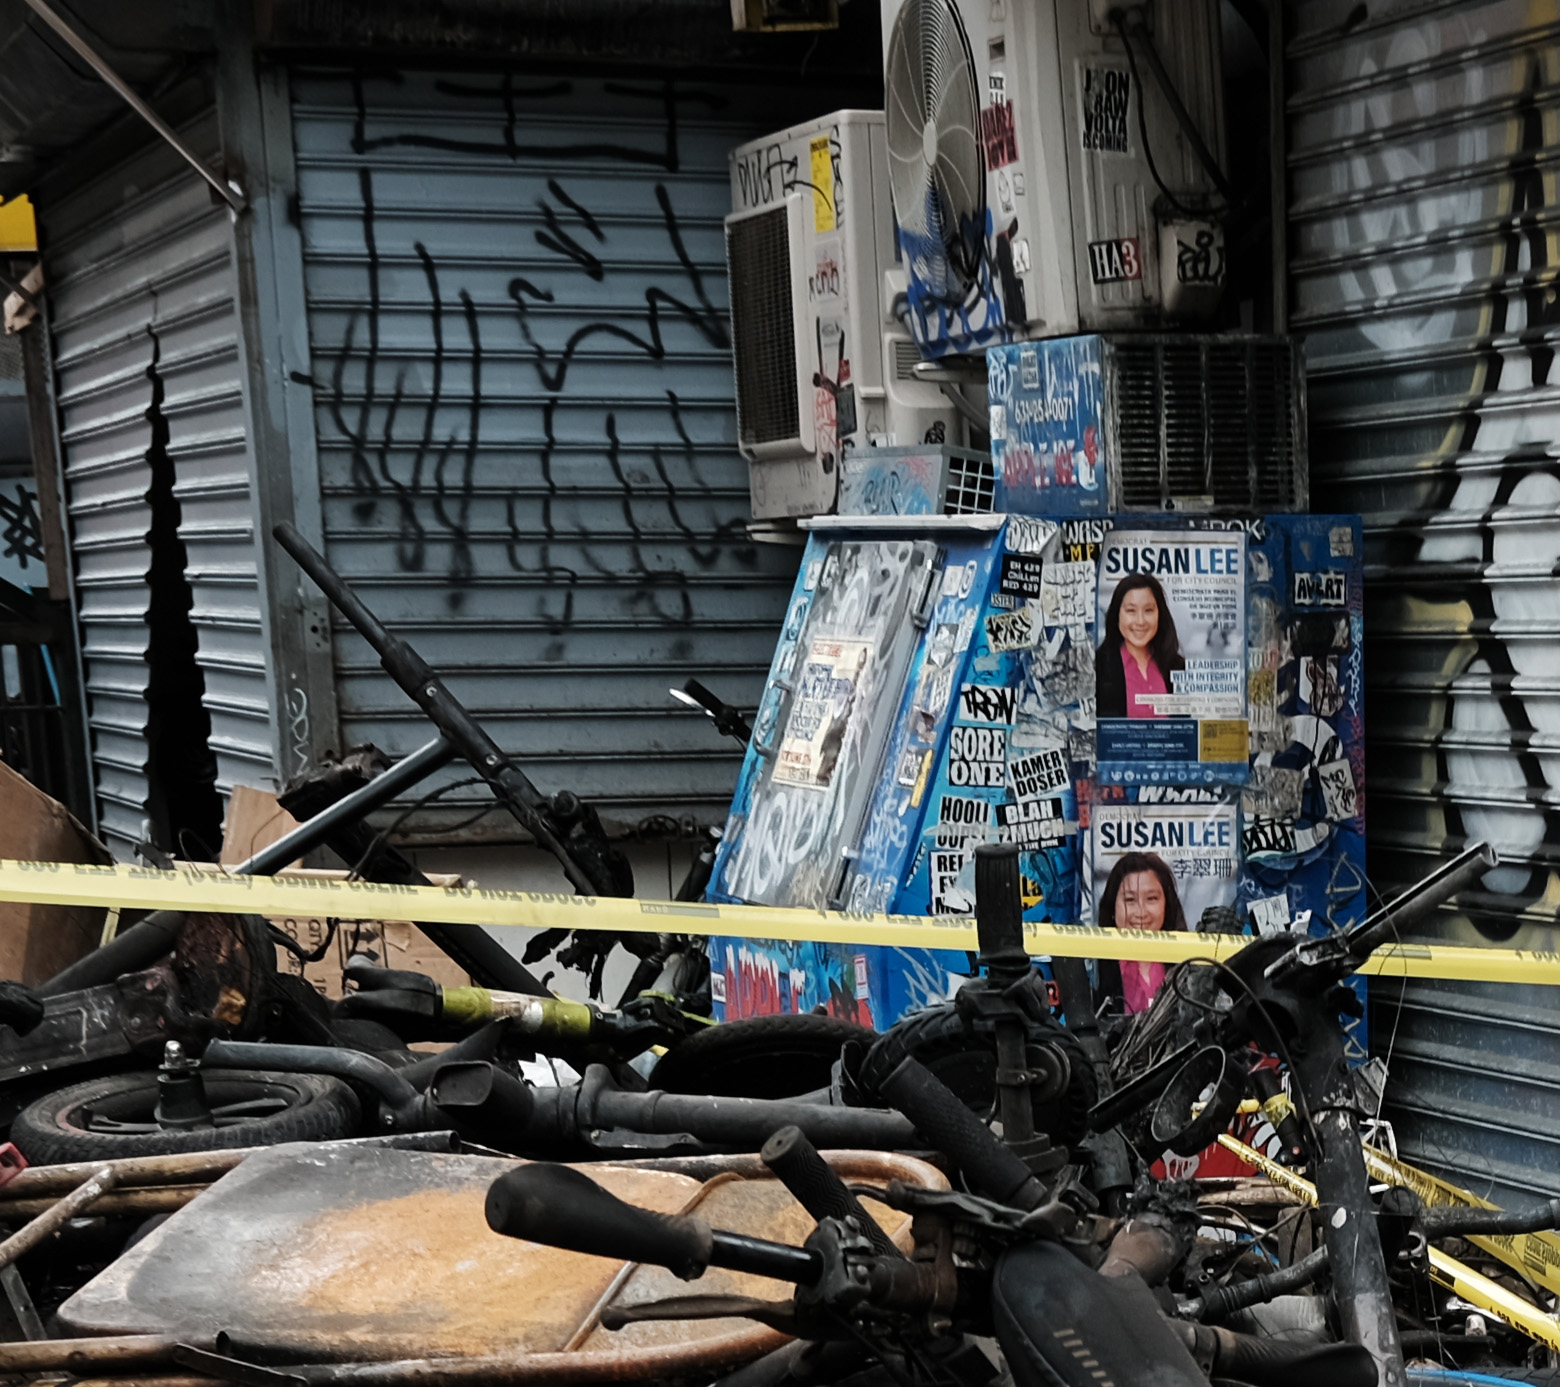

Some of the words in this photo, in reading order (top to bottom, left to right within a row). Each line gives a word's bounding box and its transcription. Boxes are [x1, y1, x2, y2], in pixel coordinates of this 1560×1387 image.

[1106, 547, 1189, 574] SUSAN
[1196, 548, 1238, 574] LEE
[1204, 577, 1237, 585] COUNCIL
[1172, 672, 1193, 681] WITH
[1195, 672, 1238, 681] INTEGRITY
[1187, 660, 1238, 669] LEADERSHIP
[1184, 683, 1239, 693] COMPASSION
[950, 727, 1005, 760] SORE
[950, 761, 1005, 786] ONE
[1011, 751, 1063, 780] KAMER
[1016, 770, 1067, 797] DOSER
[1005, 801, 1053, 824] BLAH
[1100, 822, 1184, 848] SUSAN
[1188, 822, 1230, 847] LEE
